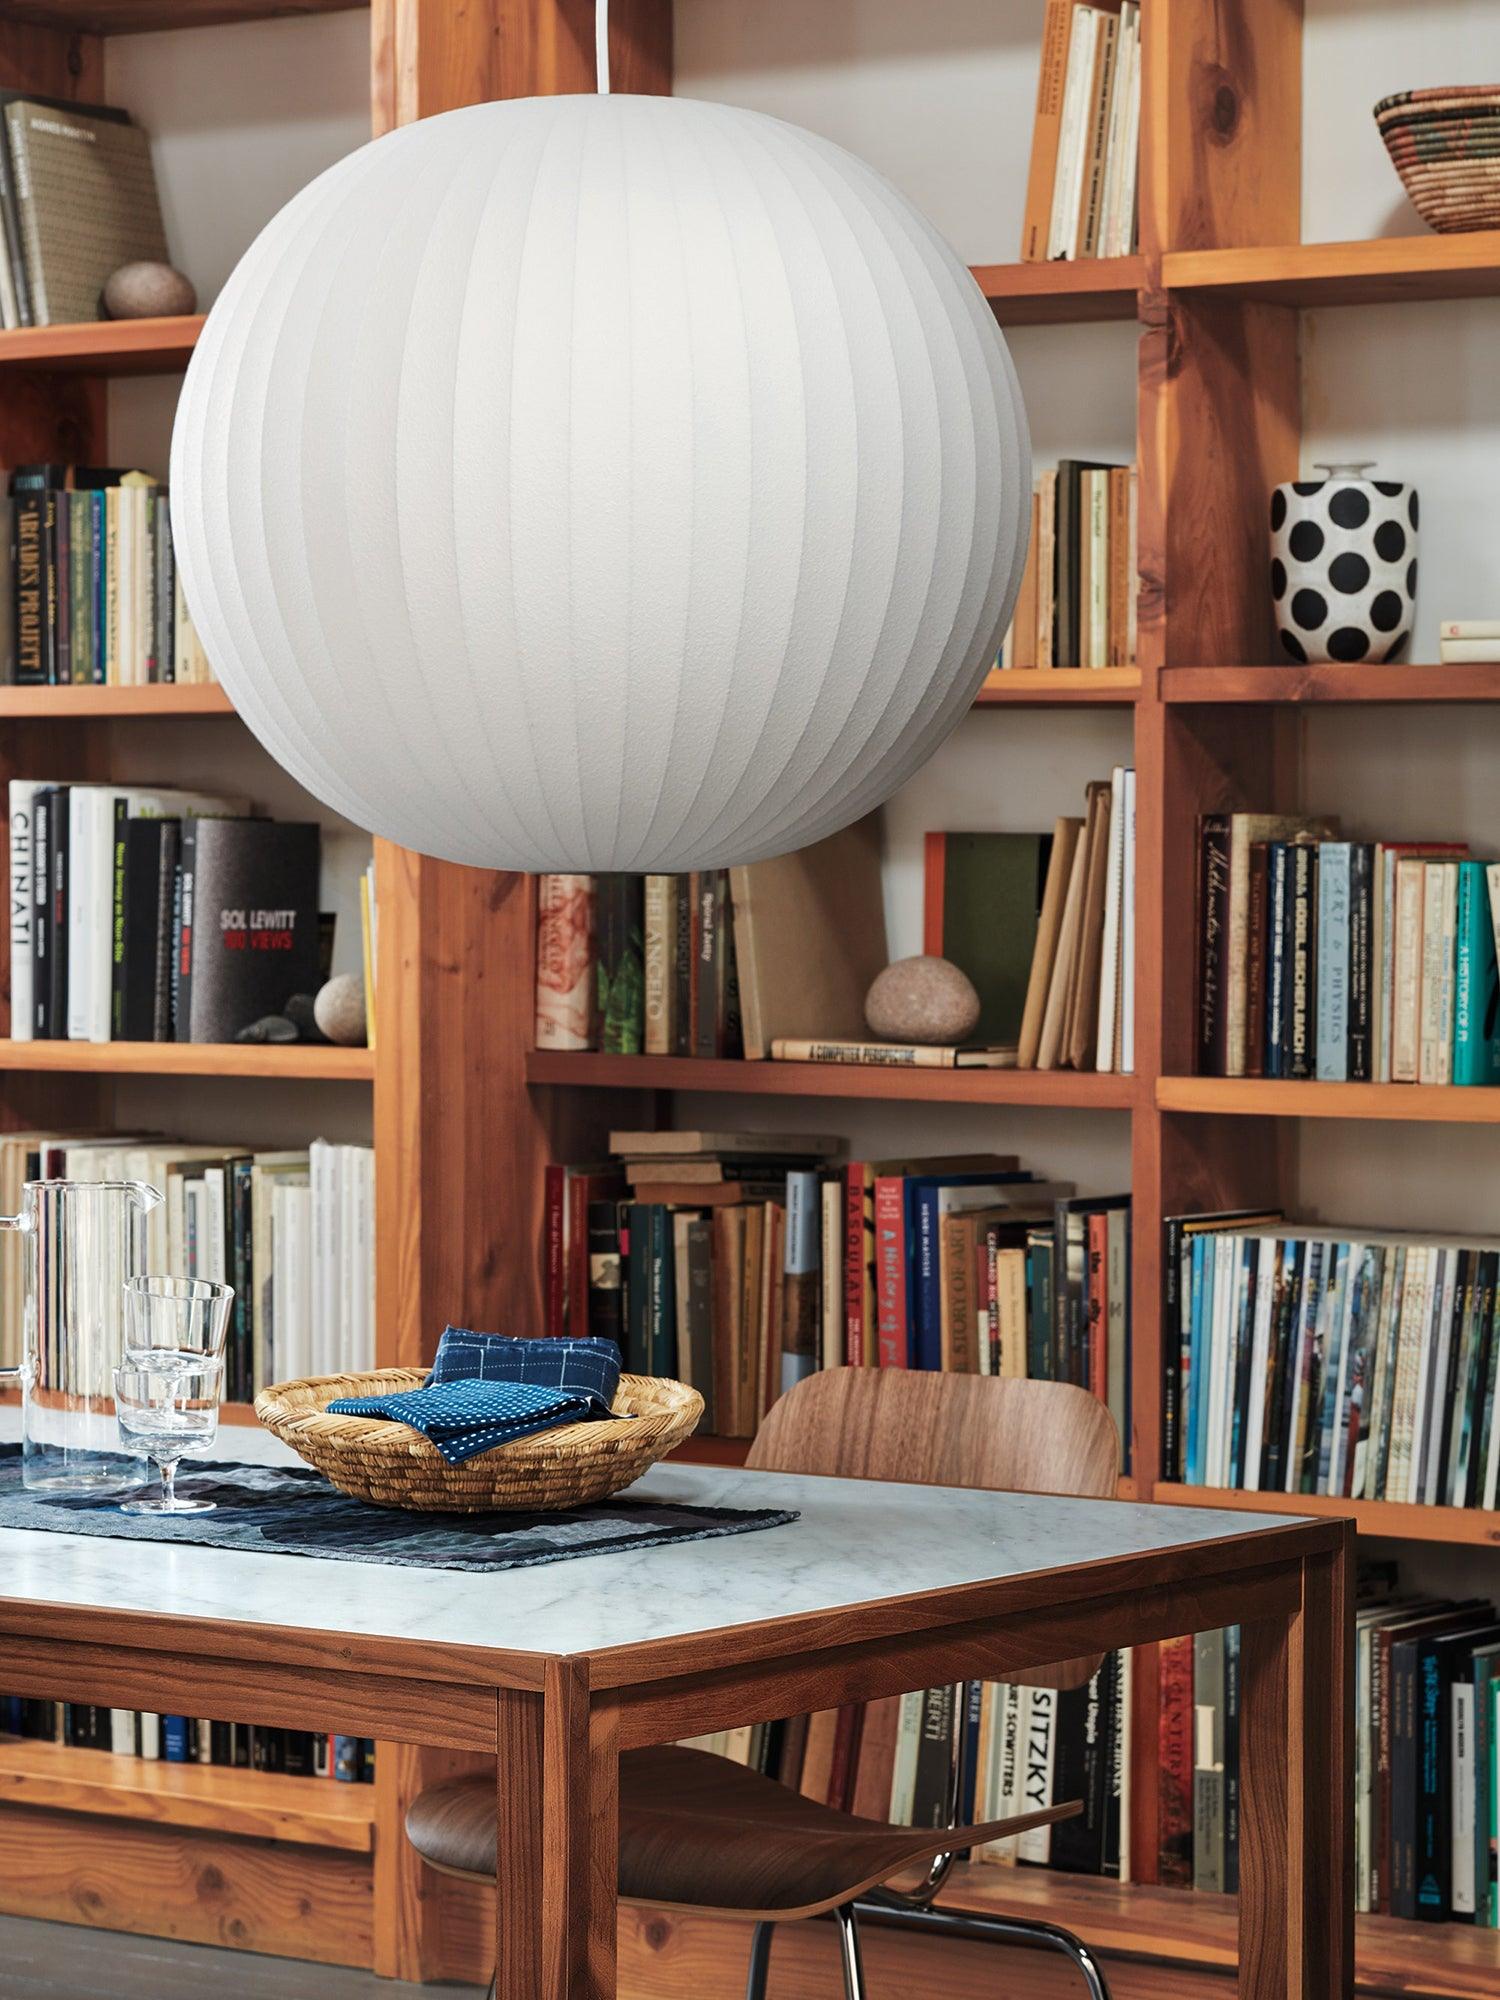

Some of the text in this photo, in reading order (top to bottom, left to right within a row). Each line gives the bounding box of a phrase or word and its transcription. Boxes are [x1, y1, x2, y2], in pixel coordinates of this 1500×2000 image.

[18, 511, 41, 669] ARCADES PROJECT
[12, 813, 30, 945] CHINATI
[1331, 878, 1344, 925] ART
[221, 909, 296, 931] SOL LEWITT
[701, 893, 713, 930] Spiral
[250, 930, 294, 951] VIEWS
[1332, 967, 1343, 1044] PHYSICS
[1458, 957, 1469, 1010] HISTORY
[1458, 1010, 1469, 1027] OF
[1458, 1030, 1468, 1042] PI
[848, 1186, 861, 1307] BASQUIAT
[881, 1229, 897, 1241] A
[880, 1247, 899, 1309] History
[951, 1228, 967, 1354] STORY OF ART
[1088, 1669, 1102, 1700] reat
[925, 1688, 943, 1740] BERTI
[1084, 1702, 1100, 1744] Utopia
[1167, 1682, 1184, 1779] CENTURY
[1002, 1684, 1019, 1797] URT SCHWITTERS
[1026, 1691, 1052, 1807] SITZKY
